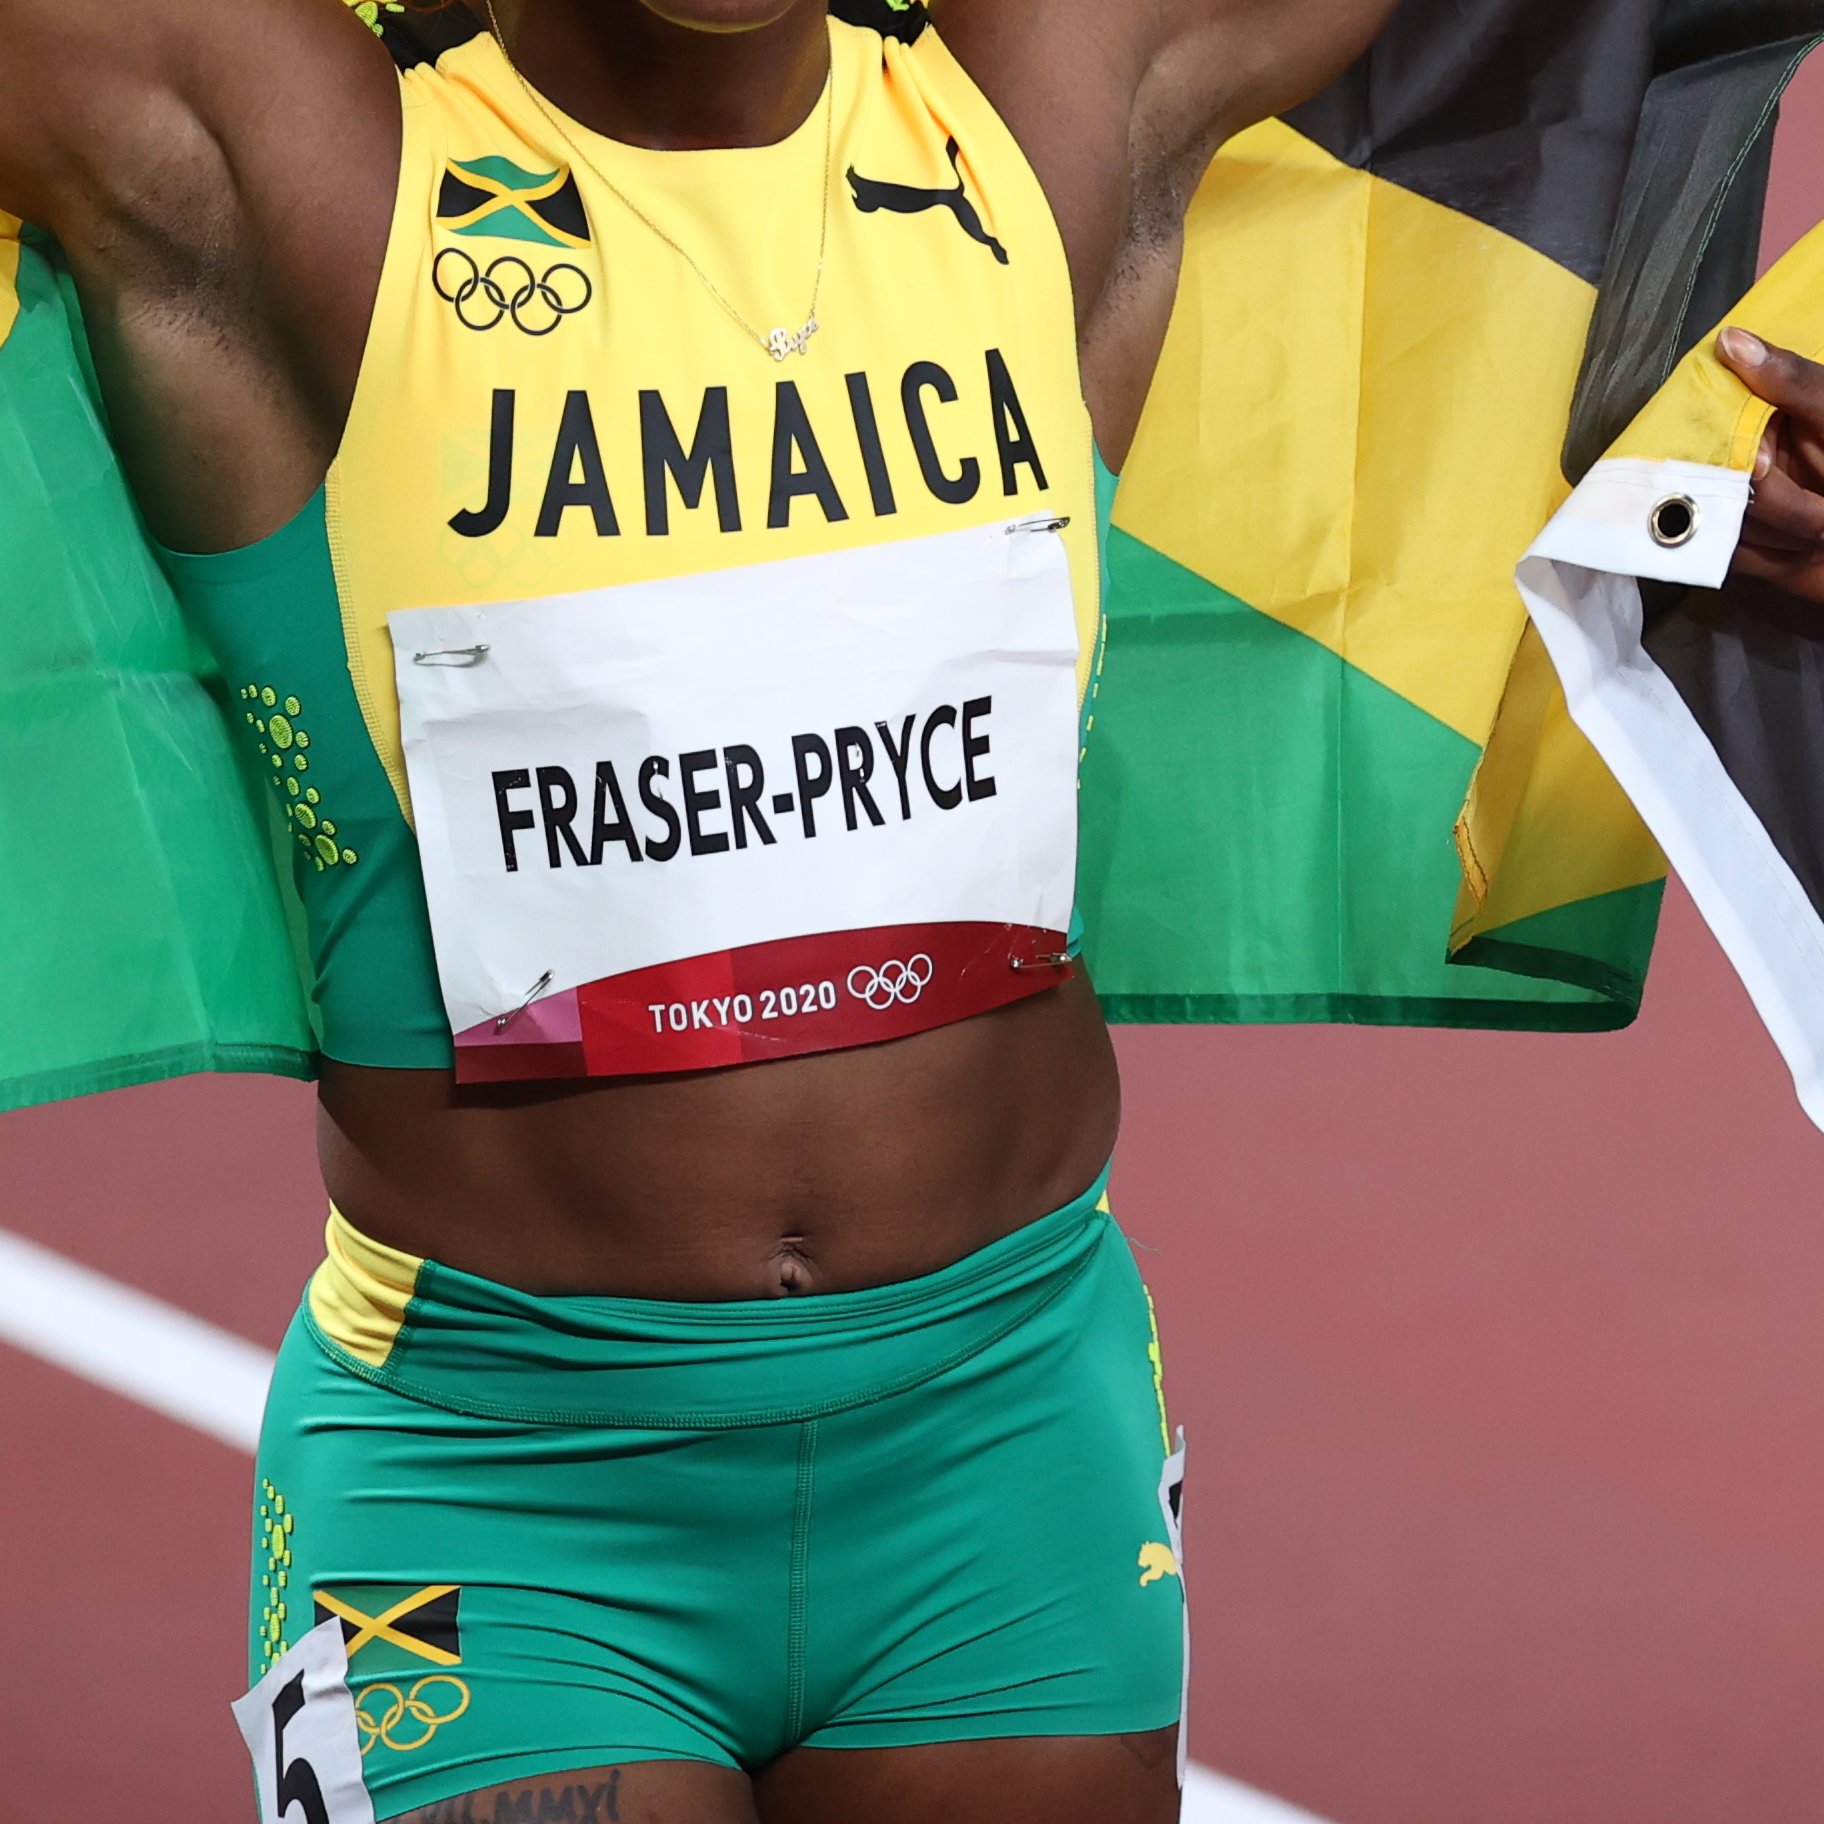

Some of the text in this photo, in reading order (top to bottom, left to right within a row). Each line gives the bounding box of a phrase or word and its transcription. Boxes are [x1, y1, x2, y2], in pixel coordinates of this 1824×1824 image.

[446, 348, 1050, 538] JAMAICA
[490, 695, 997, 873] FRASER-PRYCE
[647, 981, 836, 1034] TOKYO 2020
